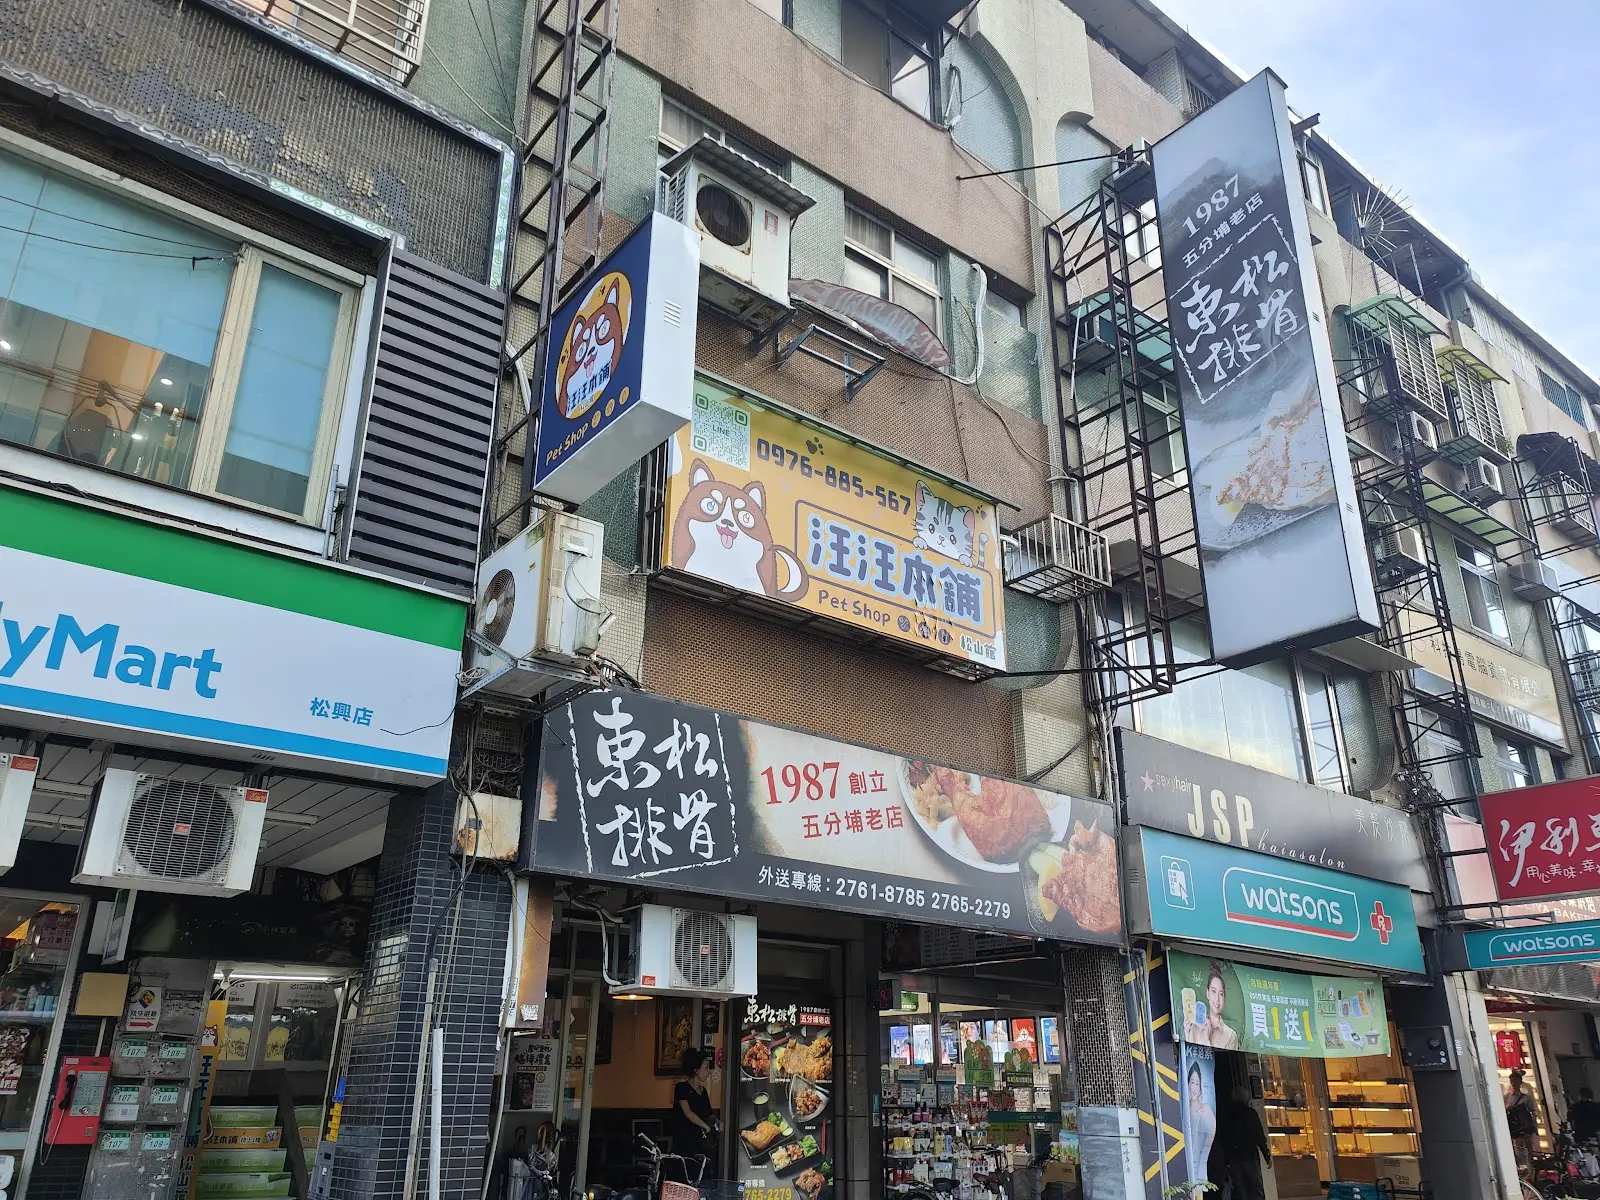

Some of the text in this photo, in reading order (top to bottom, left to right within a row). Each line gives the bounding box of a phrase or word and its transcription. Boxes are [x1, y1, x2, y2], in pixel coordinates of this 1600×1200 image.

[1182, 173, 1240, 239] 1987
[1182, 193, 1264, 268] 五分埔老店
[545, 422, 589, 467] Pet Shop
[711, 424, 730, 438] LINE
[756, 438, 912, 516] 0976-885-567
[818, 589, 892, 627] Pet Shop
[0, 604, 222, 699] yMart
[309, 696, 374, 727] 松興店
[760, 761, 888, 805] 1987 創立
[1155, 772, 1193, 793] sexyhair
[801, 805, 904, 839] 五分埔老店
[1187, 784, 1255, 848] JSP
[835, 878, 925, 907] 2761-8785
[931, 892, 1011, 920] 2765-2279
[1240, 881, 1343, 926] watsons
[1502, 933, 1596, 953] watsons
[1250, 1002, 1314, 1042] 買1送1
